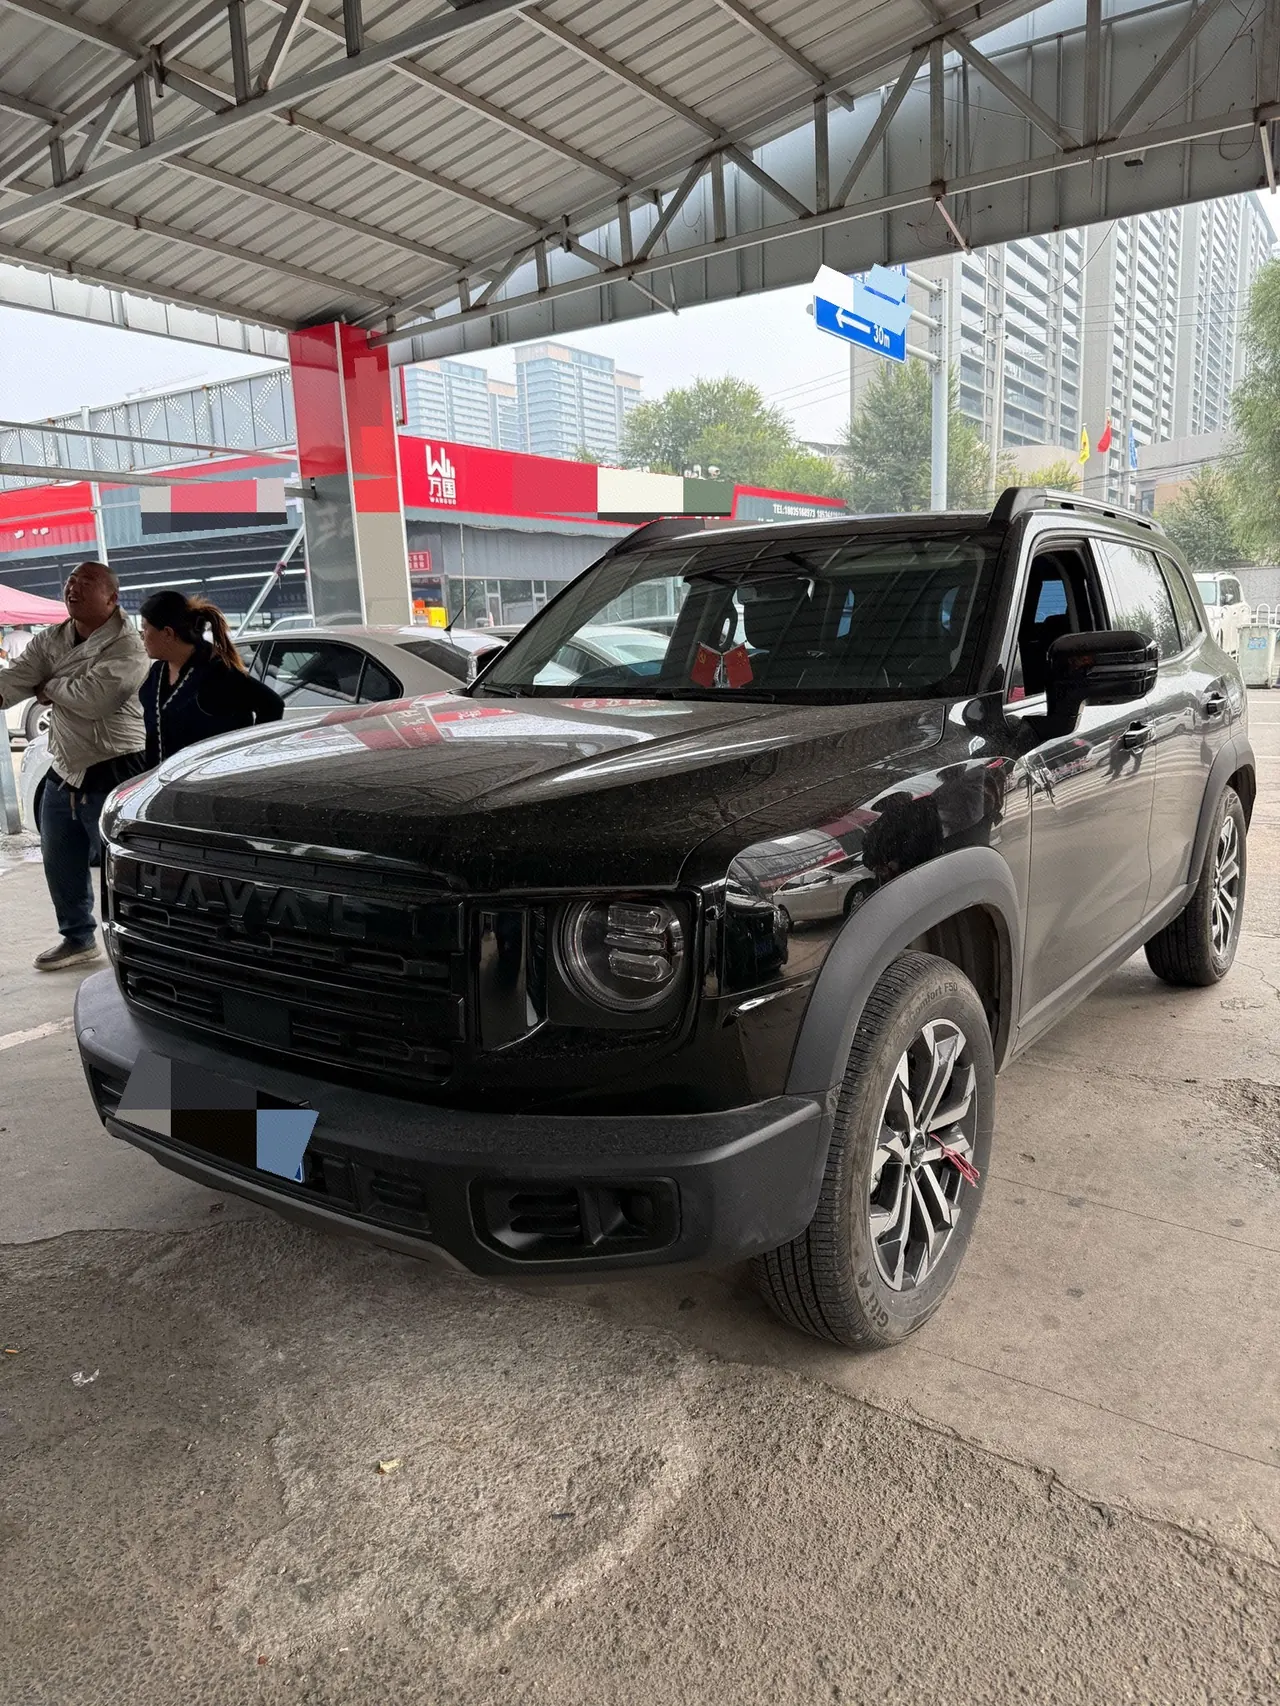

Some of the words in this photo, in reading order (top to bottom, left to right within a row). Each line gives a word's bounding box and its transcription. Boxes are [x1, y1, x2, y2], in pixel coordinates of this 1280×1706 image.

[873, 324, 891, 349] 30m
[427, 476, 457, 499] 万国
[135, 862, 367, 939] HAVAL
[943, 982, 958, 994] F50
[864, 1291, 889, 1328] Giti
